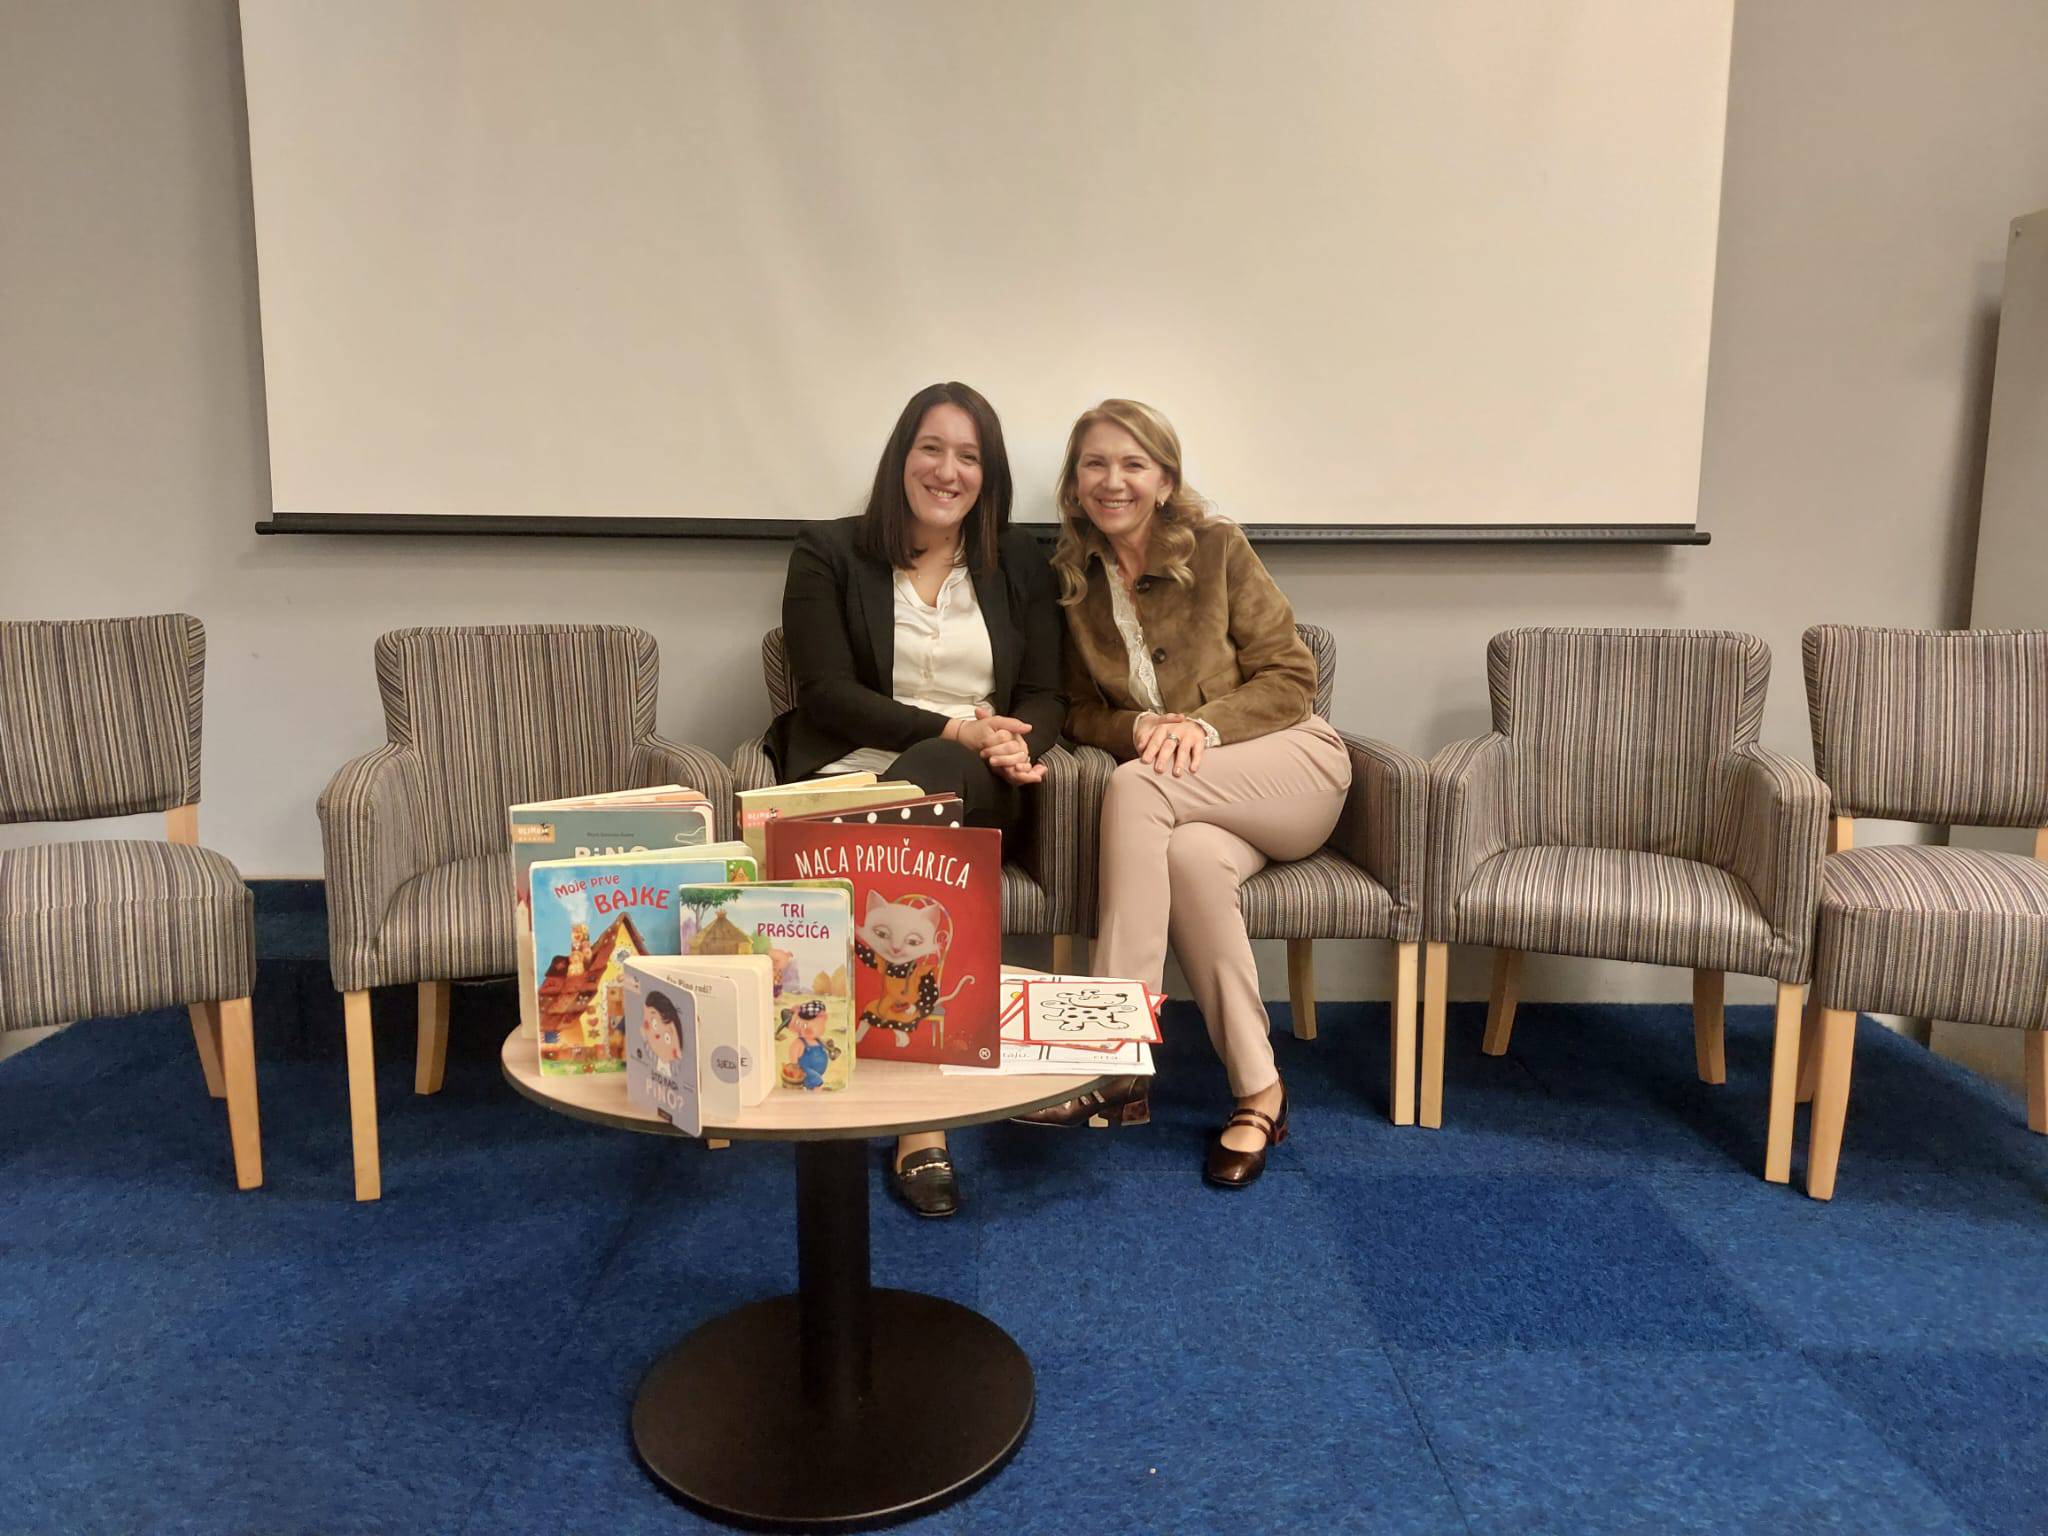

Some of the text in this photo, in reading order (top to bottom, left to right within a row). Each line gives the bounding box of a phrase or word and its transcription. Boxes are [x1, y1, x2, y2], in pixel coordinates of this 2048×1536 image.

[794, 838, 970, 889] MACA PAPUČARICA
[554, 875, 620, 898] Moje prve
[594, 885, 670, 915] BAJKE
[780, 903, 805, 918] TRI
[757, 918, 830, 939] PRAŠČIĆA
